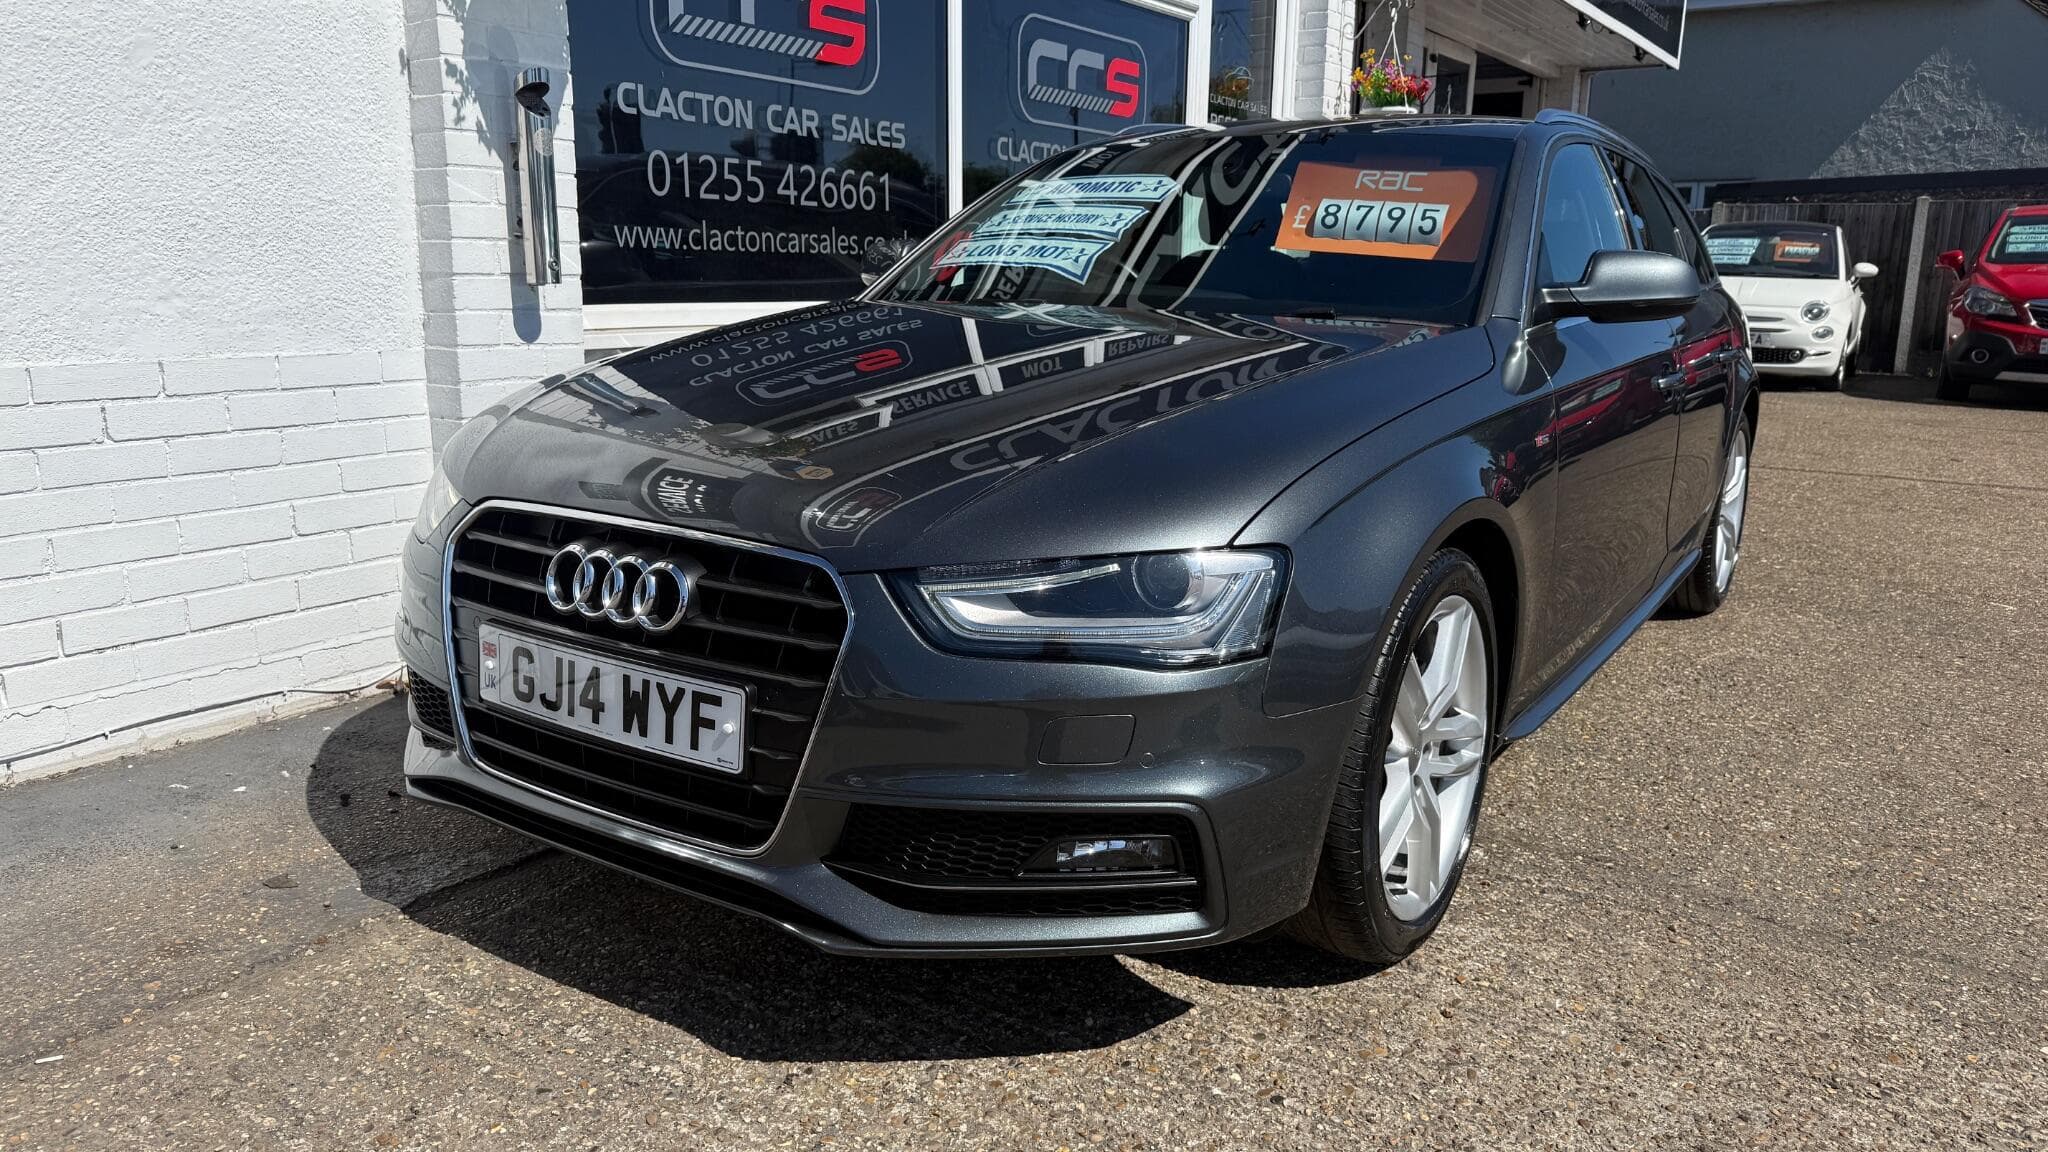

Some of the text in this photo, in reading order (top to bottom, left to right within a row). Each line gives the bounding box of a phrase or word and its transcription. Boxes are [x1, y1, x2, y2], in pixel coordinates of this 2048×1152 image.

[616, 81, 906, 149] CLACTON CAR SALES
[997, 136, 1067, 164] CLACTO
[647, 149, 891, 212] 01255 426661
[1012, 213, 1056, 225] SRVICE
[966, 244, 1074, 259] LONG MOT
[484, 671, 498, 690] UK
[512, 646, 723, 752] GJ14 WYF
